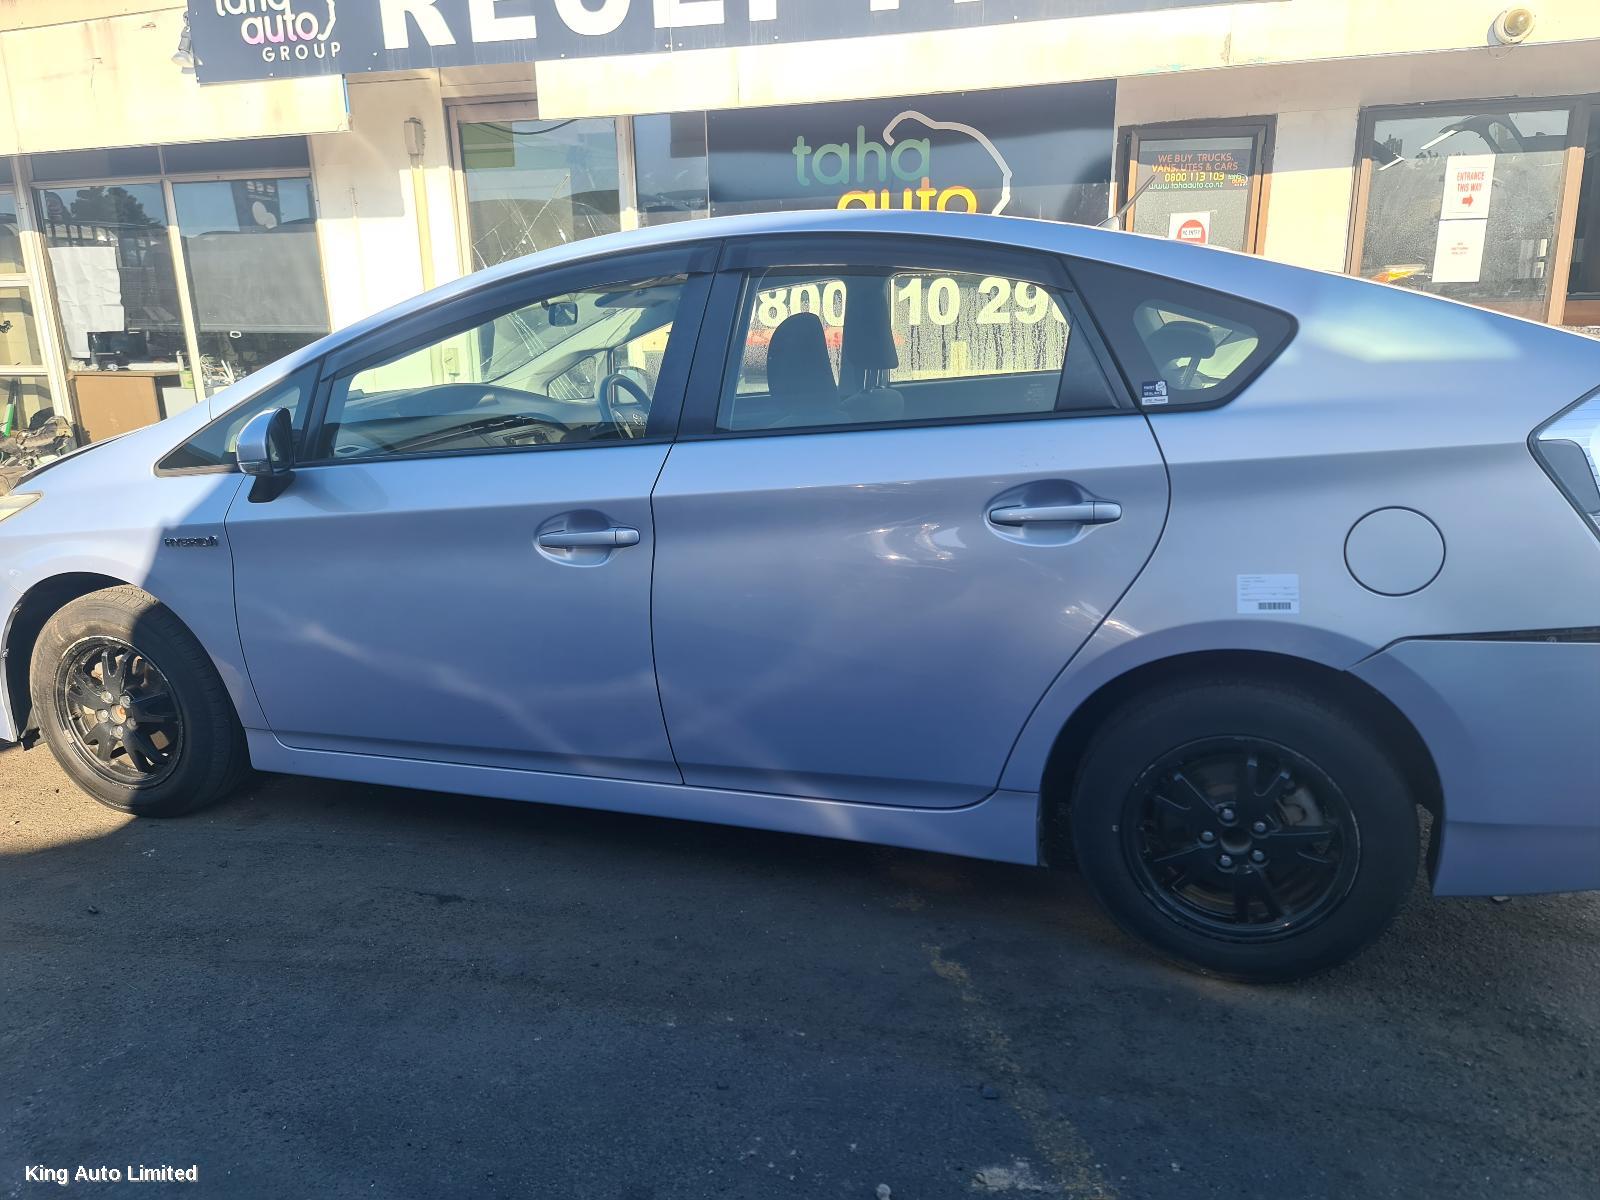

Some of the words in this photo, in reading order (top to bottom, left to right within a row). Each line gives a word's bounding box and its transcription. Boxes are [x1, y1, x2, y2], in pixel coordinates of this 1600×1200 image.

[241, 9, 319, 45] auto
[262, 41, 341, 62] GROUP
[792, 124, 931, 186] taha
[1158, 154, 1173, 163] WE
[1174, 154, 1193, 163] BUY
[1180, 163, 1203, 172] UTES
[1205, 163, 1212, 171] &
[1214, 162, 1239, 171] CARS
[1164, 172, 1187, 182] 0800
[1190, 171, 1206, 182] 113
[1209, 171, 1225, 181] 103
[1456, 171, 1485, 181] ENTRANCE
[1457, 183, 1470, 193] THIS
